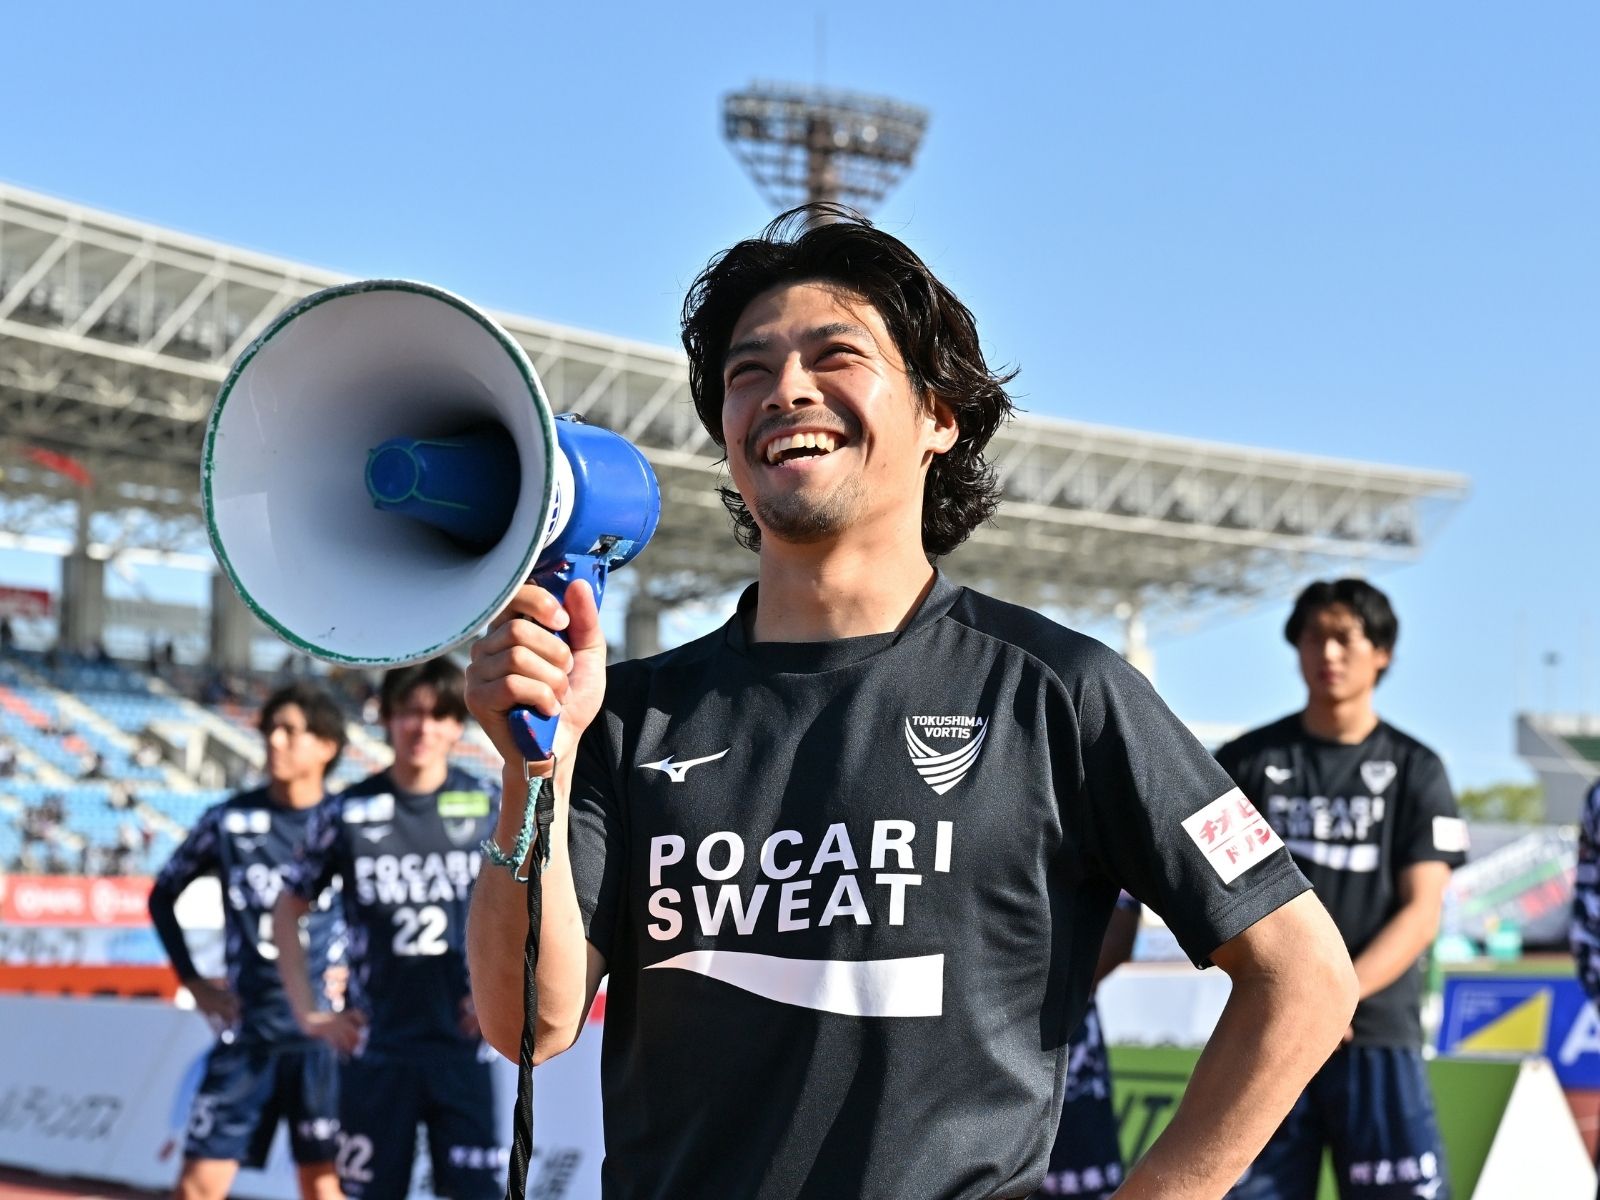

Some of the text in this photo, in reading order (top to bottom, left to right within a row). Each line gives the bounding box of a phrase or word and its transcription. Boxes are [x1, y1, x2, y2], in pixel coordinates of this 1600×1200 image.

[912, 715, 983, 727] TOKUSHIMA
[924, 727, 971, 739] VORTIS
[649, 819, 954, 887] POCARI
[392, 905, 448, 956] 22
[647, 873, 923, 941] SWEAT
